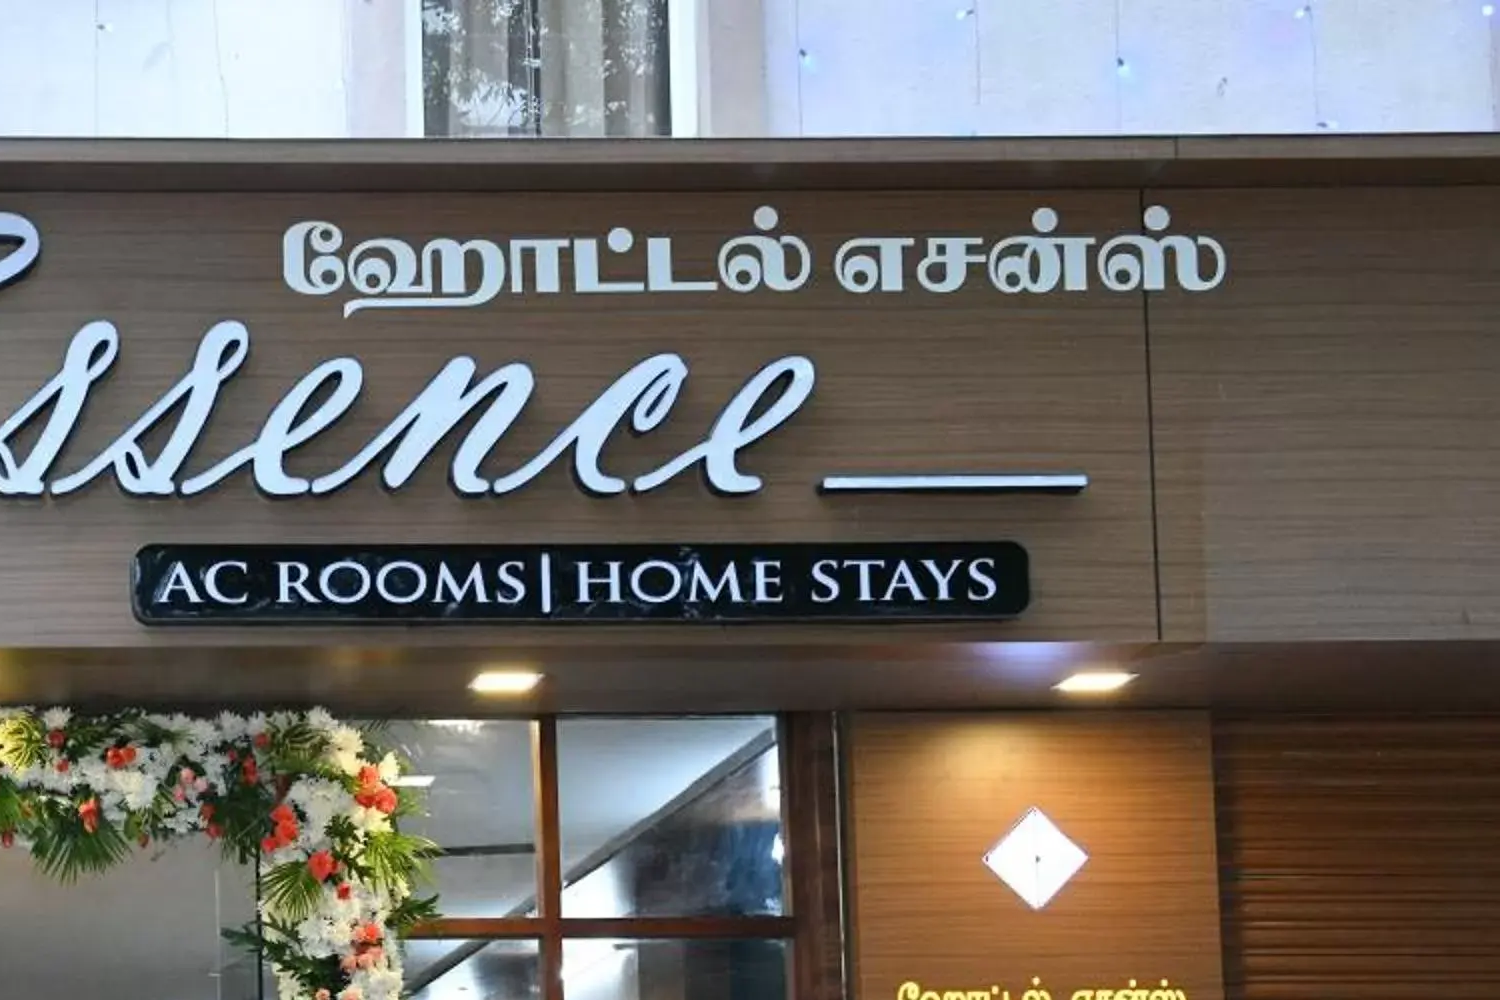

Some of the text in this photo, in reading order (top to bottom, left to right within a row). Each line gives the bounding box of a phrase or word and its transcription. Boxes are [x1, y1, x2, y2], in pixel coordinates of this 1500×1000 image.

[282, 206, 1226, 318] ஹோட்டல் எசன்ஸ்
[156, 559, 998, 605] AC ROOMS HOME STAYS
